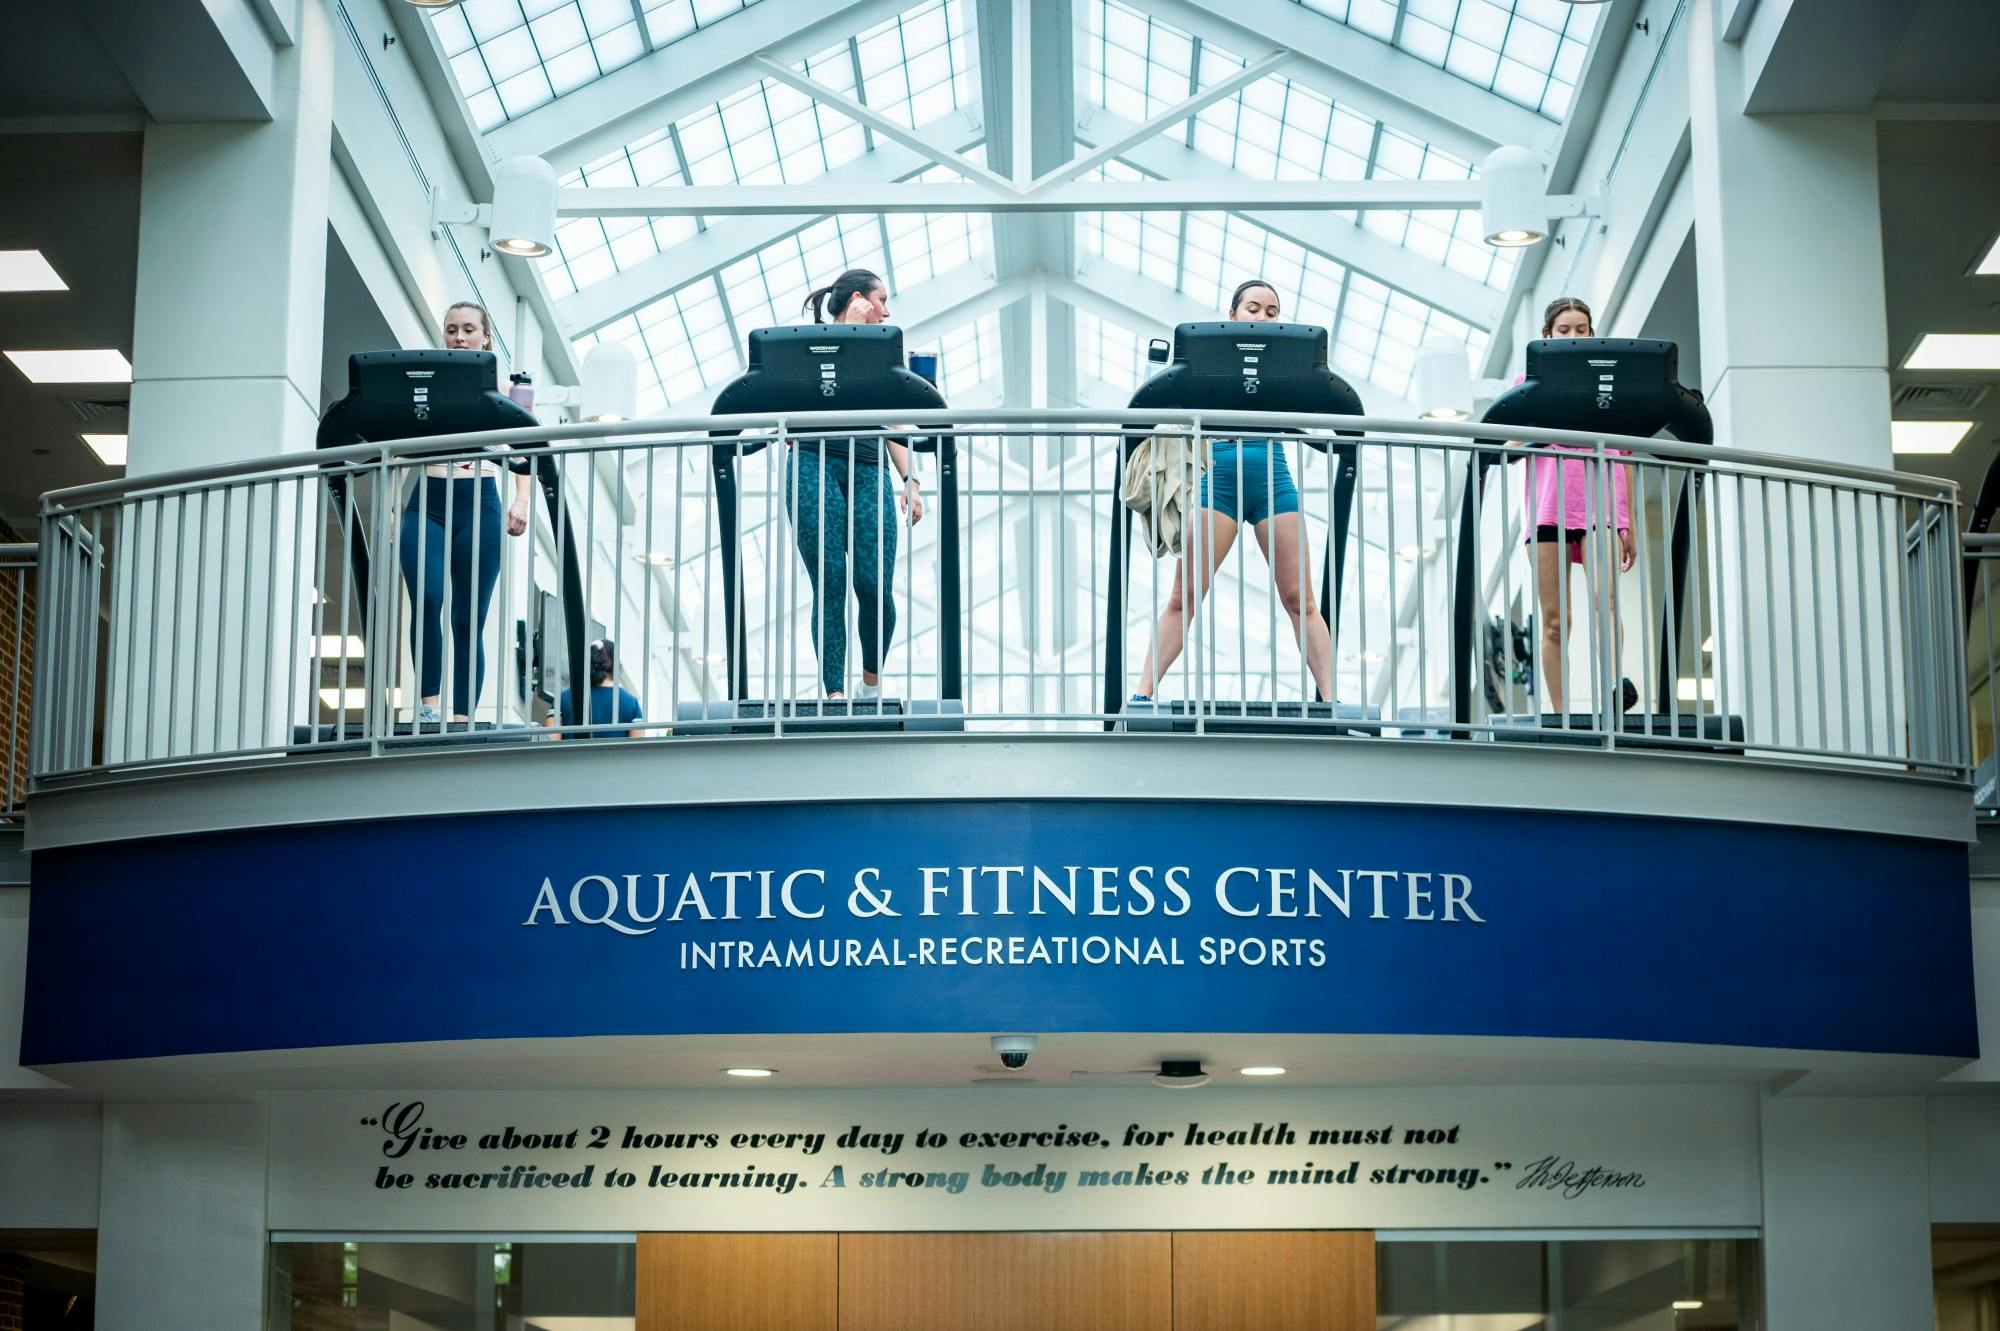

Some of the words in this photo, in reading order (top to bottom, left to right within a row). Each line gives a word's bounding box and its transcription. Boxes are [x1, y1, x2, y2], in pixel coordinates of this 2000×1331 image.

[523, 868, 825, 936] AQUATIC
[847, 867, 902, 918] &
[918, 865, 1191, 917] FITNESS
[1214, 866, 1486, 923] CENTER
[680, 936, 1185, 970] INTRAMURAL-RECREATIONAL
[1199, 936, 1326, 967] SPORTS
[479, 1125, 577, 1150] about
[585, 1125, 611, 1150] 2
[621, 1124, 720, 1150] hours
[730, 1132, 827, 1156] every
[836, 1124, 905, 1156] day
[915, 1126, 949, 1149] to
[959, 1124, 1111, 1150] exercise,
[1122, 1122, 1175, 1148] for
[1184, 1121, 1297, 1147] health
[1308, 1123, 1394, 1146] must
[1403, 1123, 1460, 1146] not
[375, 1165, 415, 1190] be
[425, 1163, 596, 1190] sacrificed
[604, 1167, 637, 1189] to
[648, 1164, 808, 1195] learning.
[819, 1164, 847, 1188] A
[859, 1167, 970, 1195] strong
[981, 1163, 1068, 1194] body
[1078, 1161, 1190, 1187] makes
[1201, 1161, 1256, 1186] the
[1267, 1160, 1360, 1186] mind
